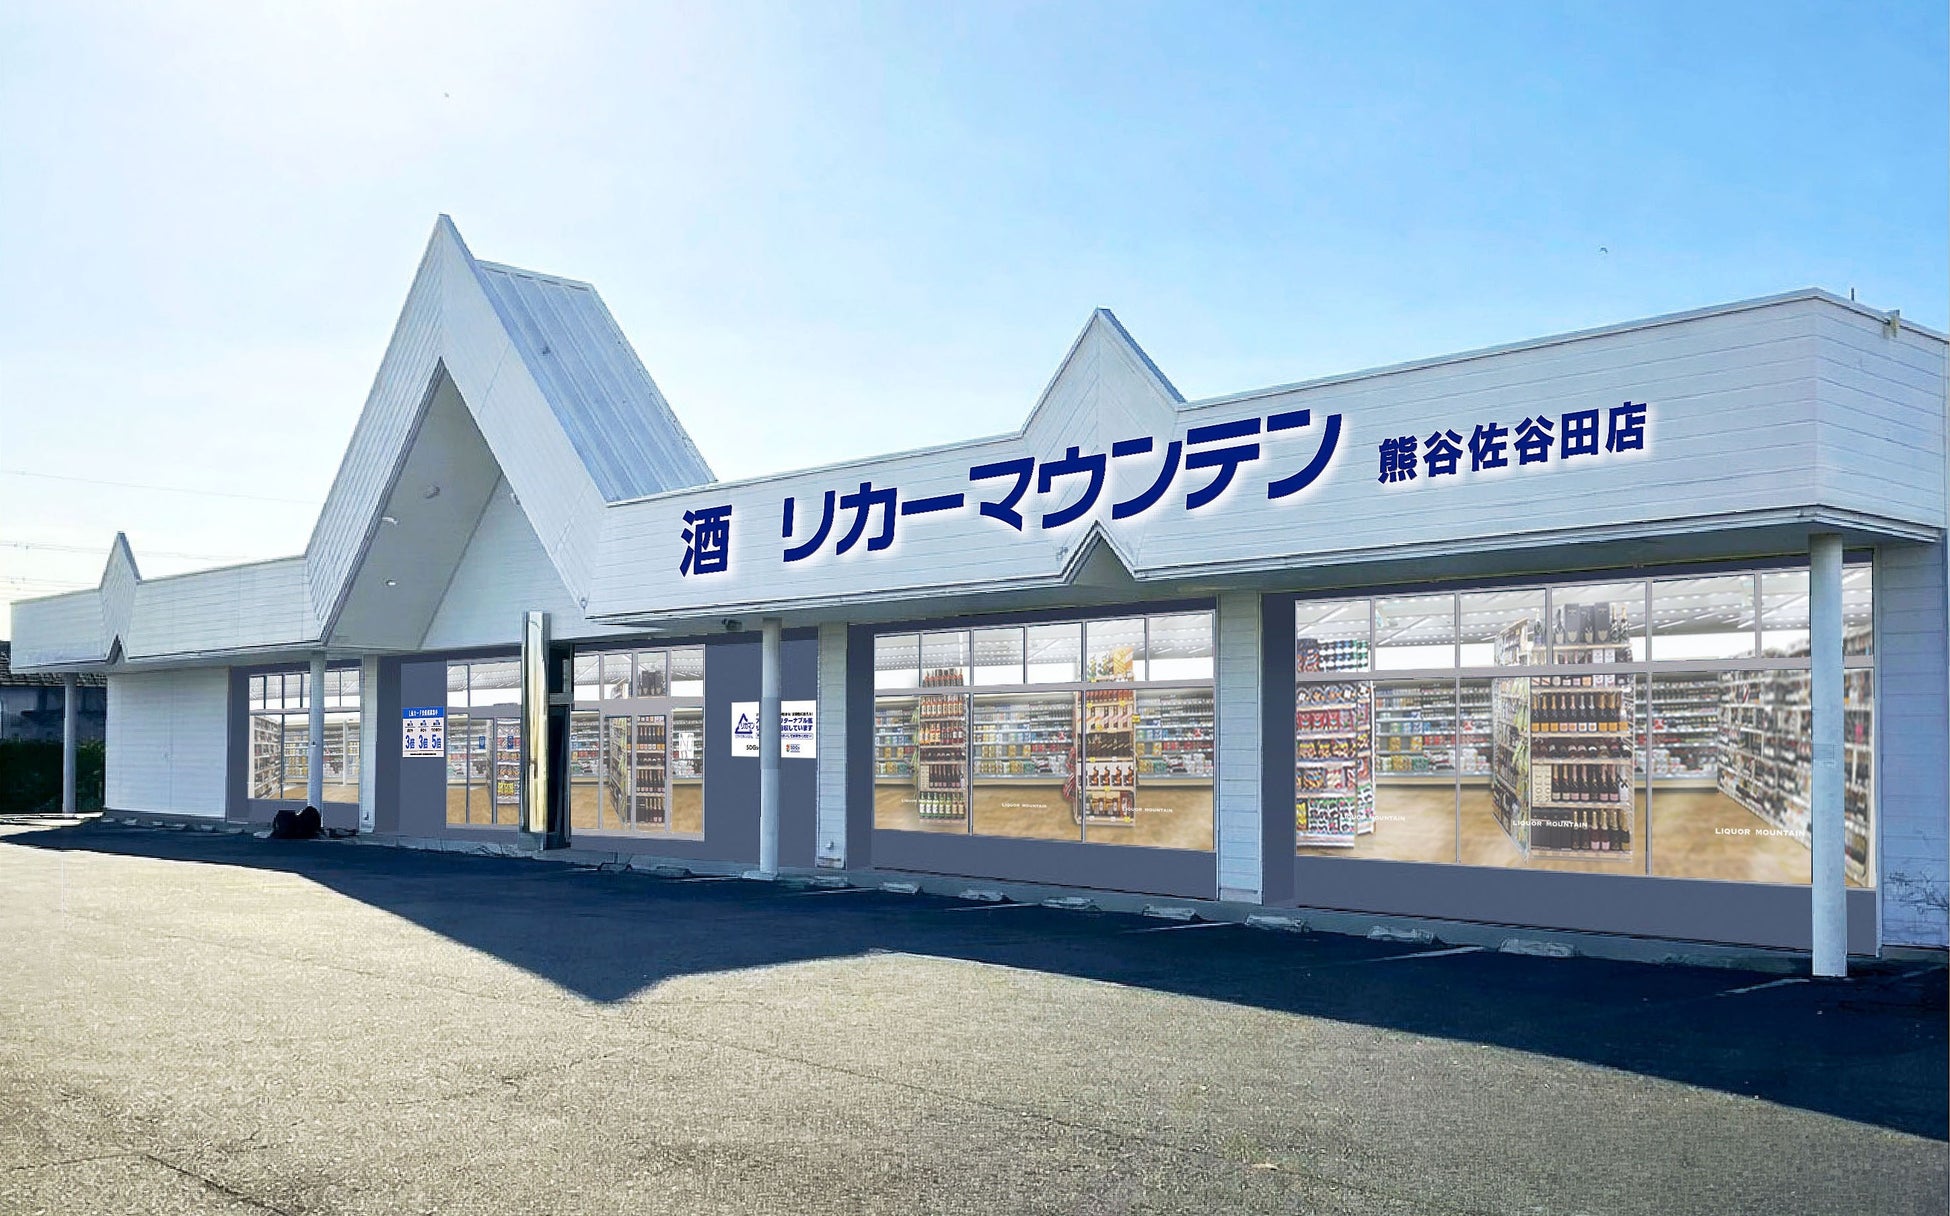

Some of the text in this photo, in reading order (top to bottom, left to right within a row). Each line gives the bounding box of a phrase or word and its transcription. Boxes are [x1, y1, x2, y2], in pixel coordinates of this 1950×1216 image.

[681, 401, 1647, 575] 酒 リカーマウンテン 熊谷佐谷田店
[1714, 827, 1805, 836] LIQUOR MOUNTAIN
